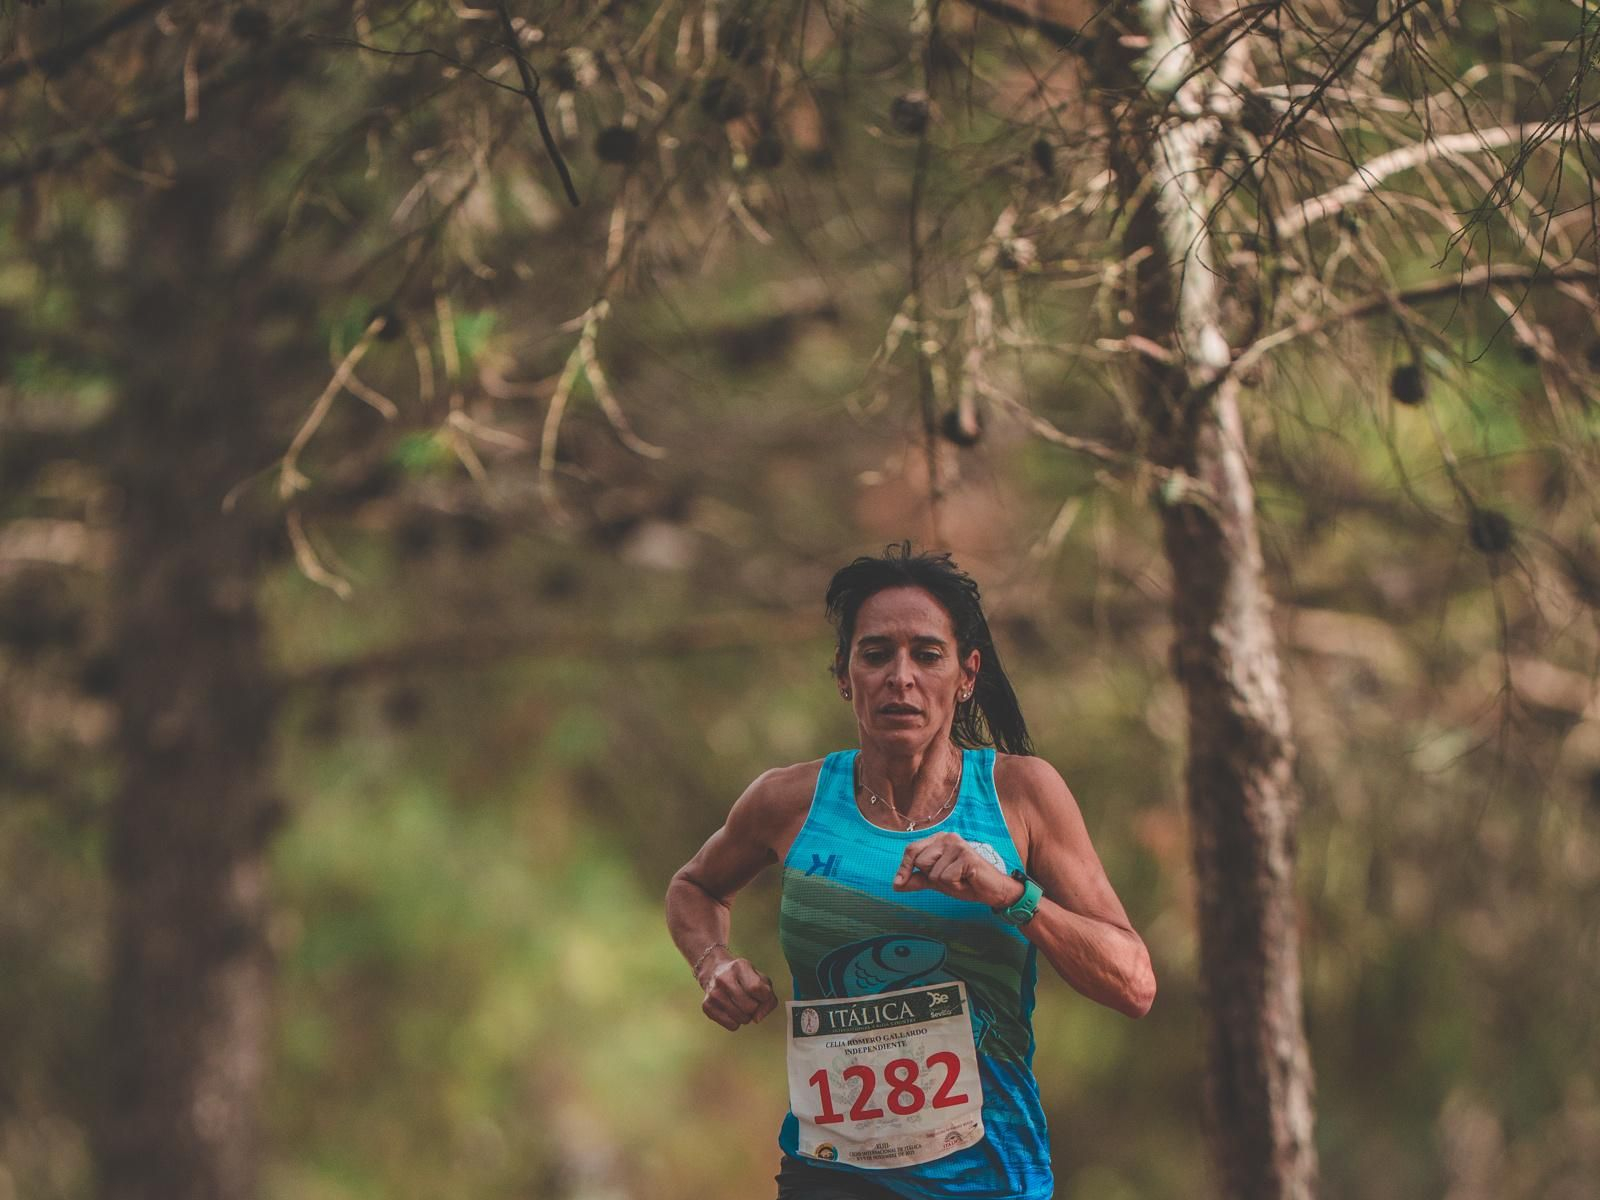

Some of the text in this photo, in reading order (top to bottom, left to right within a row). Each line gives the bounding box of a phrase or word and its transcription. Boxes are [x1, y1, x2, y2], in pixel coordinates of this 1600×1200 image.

[829, 1004, 914, 1028] ITÁLICA
[825, 1028, 928, 1049] CELIA ROMERO GALLARDO
[844, 1040, 907, 1055] INDEPENDIENTE
[809, 1051, 969, 1124] 1282
